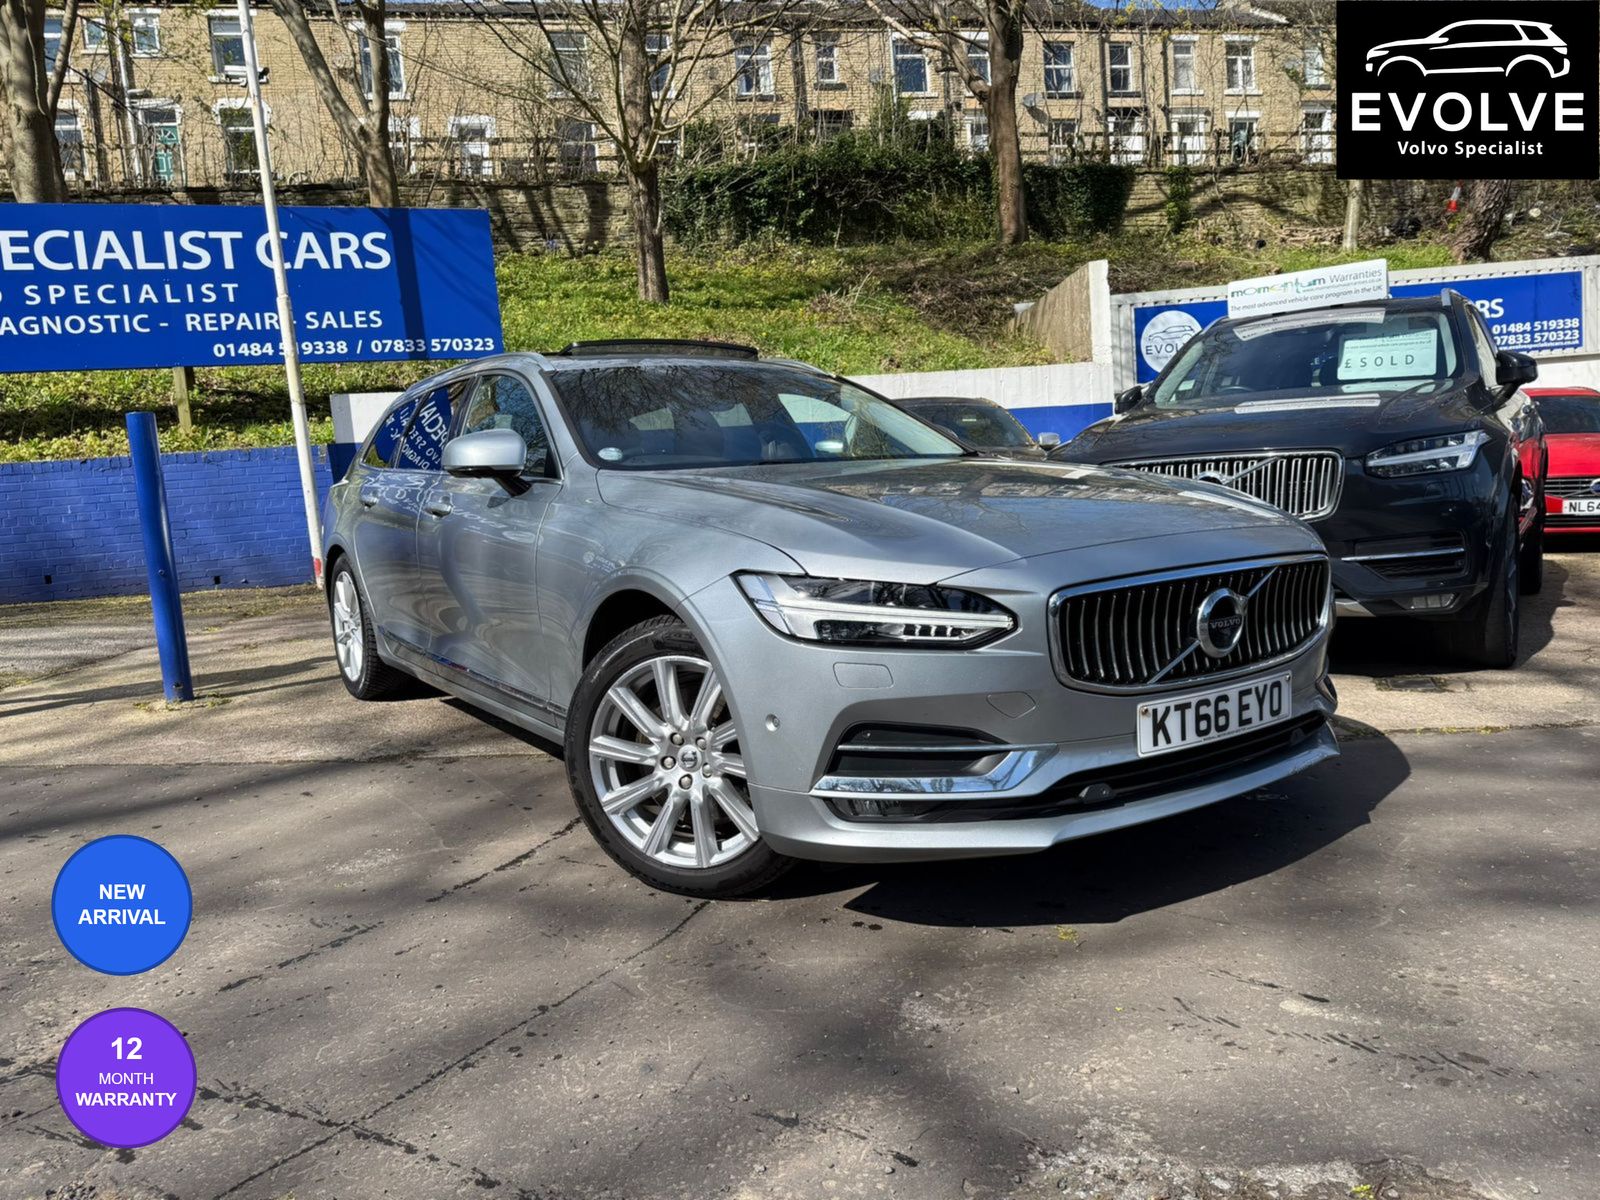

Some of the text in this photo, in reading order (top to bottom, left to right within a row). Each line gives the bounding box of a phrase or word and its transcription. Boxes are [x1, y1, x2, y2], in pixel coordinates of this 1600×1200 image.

[0, 229, 391, 271] ECIALIST CARS
[1231, 268, 1382, 298] momentum Warranties
[23, 283, 239, 305] SPECIALIST
[1257, 299, 1287, 309] advanced
[1288, 296, 1309, 306] vehicle
[1310, 294, 1324, 302] care
[1325, 290, 1353, 301] program
[1361, 285, 1372, 294] the
[1373, 284, 1383, 293] UK
[1476, 298, 1505, 318] RS
[0, 314, 151, 336] AGNOSTIC
[305, 310, 383, 330] SALES
[1492, 318, 1580, 335] 01484 519338
[1533, 329, 1580, 343] 570323
[213, 343, 274, 358] 01484
[370, 339, 426, 353] 07833
[431, 337, 495, 352] 570323
[1146, 343, 1184, 355] EVOL
[1360, 354, 1415, 368] SOLD
[1210, 618, 1241, 629] VOLVO
[1152, 681, 1282, 747] KT66 EYO
